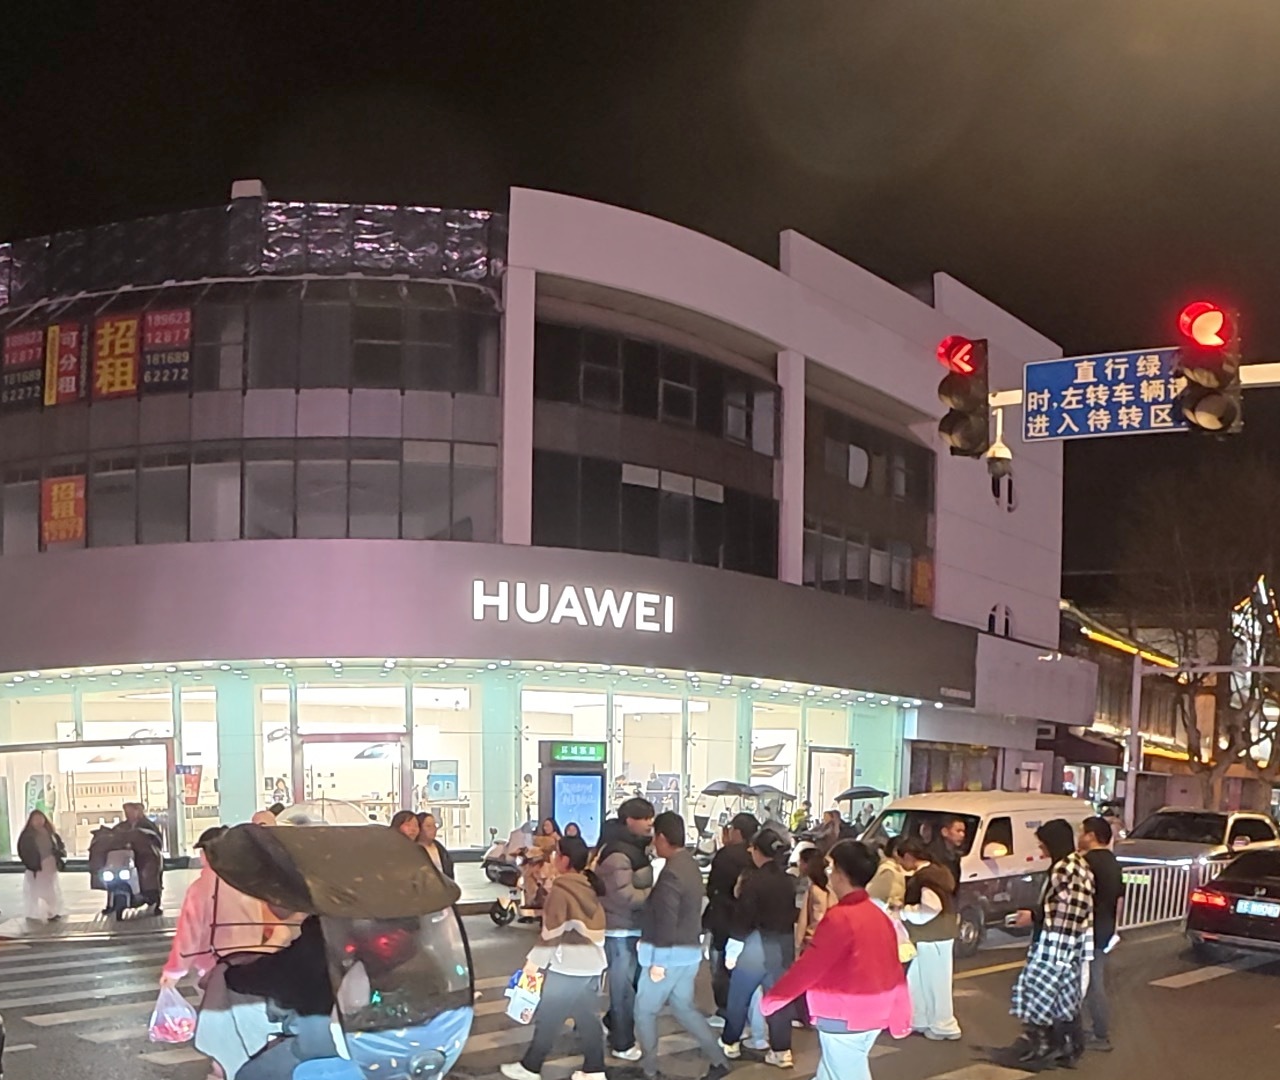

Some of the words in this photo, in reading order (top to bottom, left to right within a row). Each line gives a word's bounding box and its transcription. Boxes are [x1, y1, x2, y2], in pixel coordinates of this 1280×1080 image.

[96, 319, 137, 394] 招租
[146, 328, 190, 344] 12877
[59, 331, 79, 394] 可分租
[143, 368, 189, 383] 62272
[52, 482, 76, 519] 招租
[473, 580, 674, 633] HUAWEI
